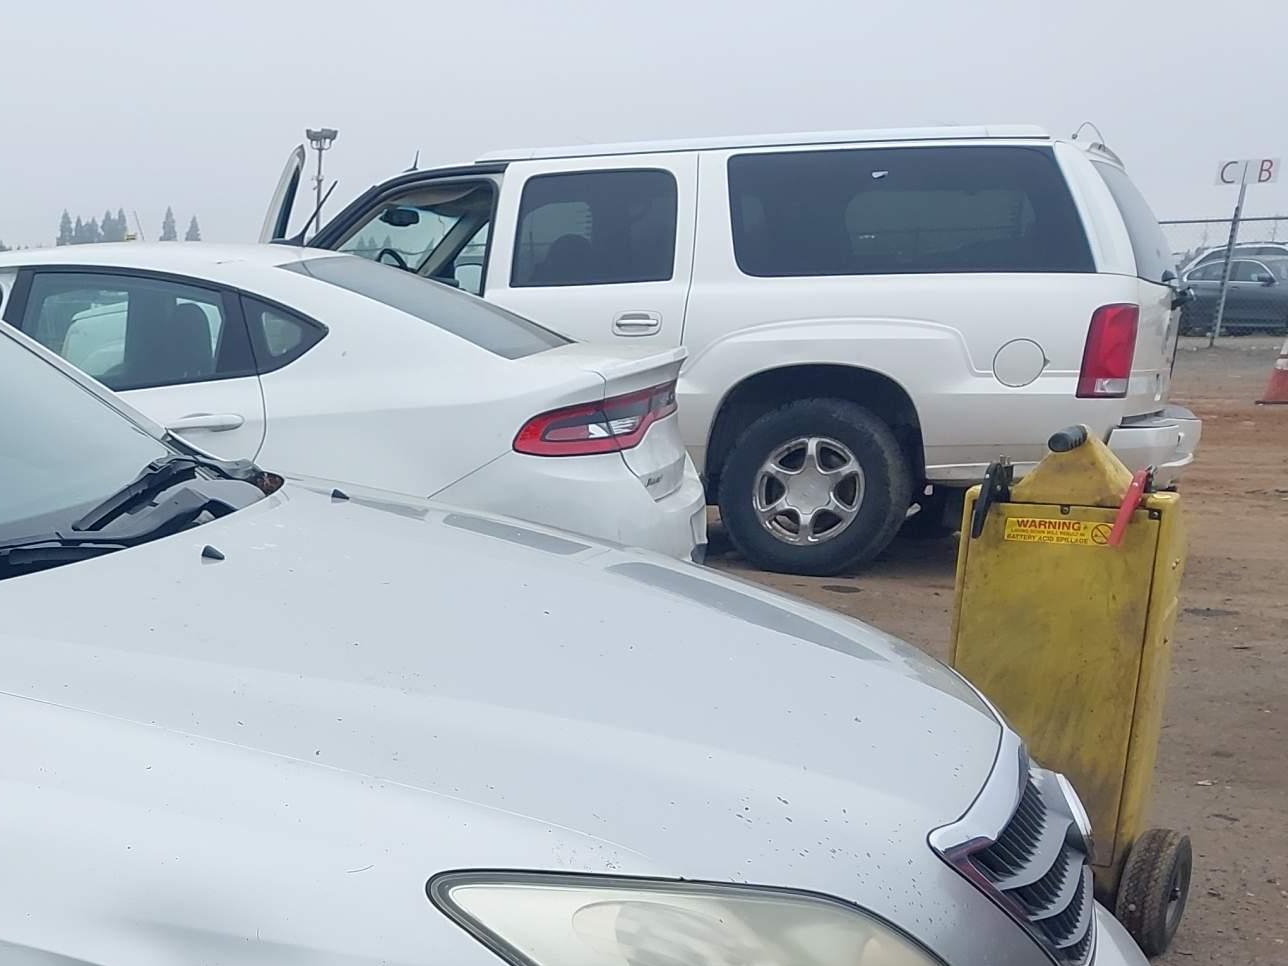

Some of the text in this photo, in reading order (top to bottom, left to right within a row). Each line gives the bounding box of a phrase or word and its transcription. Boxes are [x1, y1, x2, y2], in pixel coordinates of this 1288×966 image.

[1220, 159, 1274, 184] C B
[1016, 519, 1081, 532] WARNING
[1006, 533, 1035, 541] BATTERY
[1055, 536, 1089, 544] SPILLAGE
